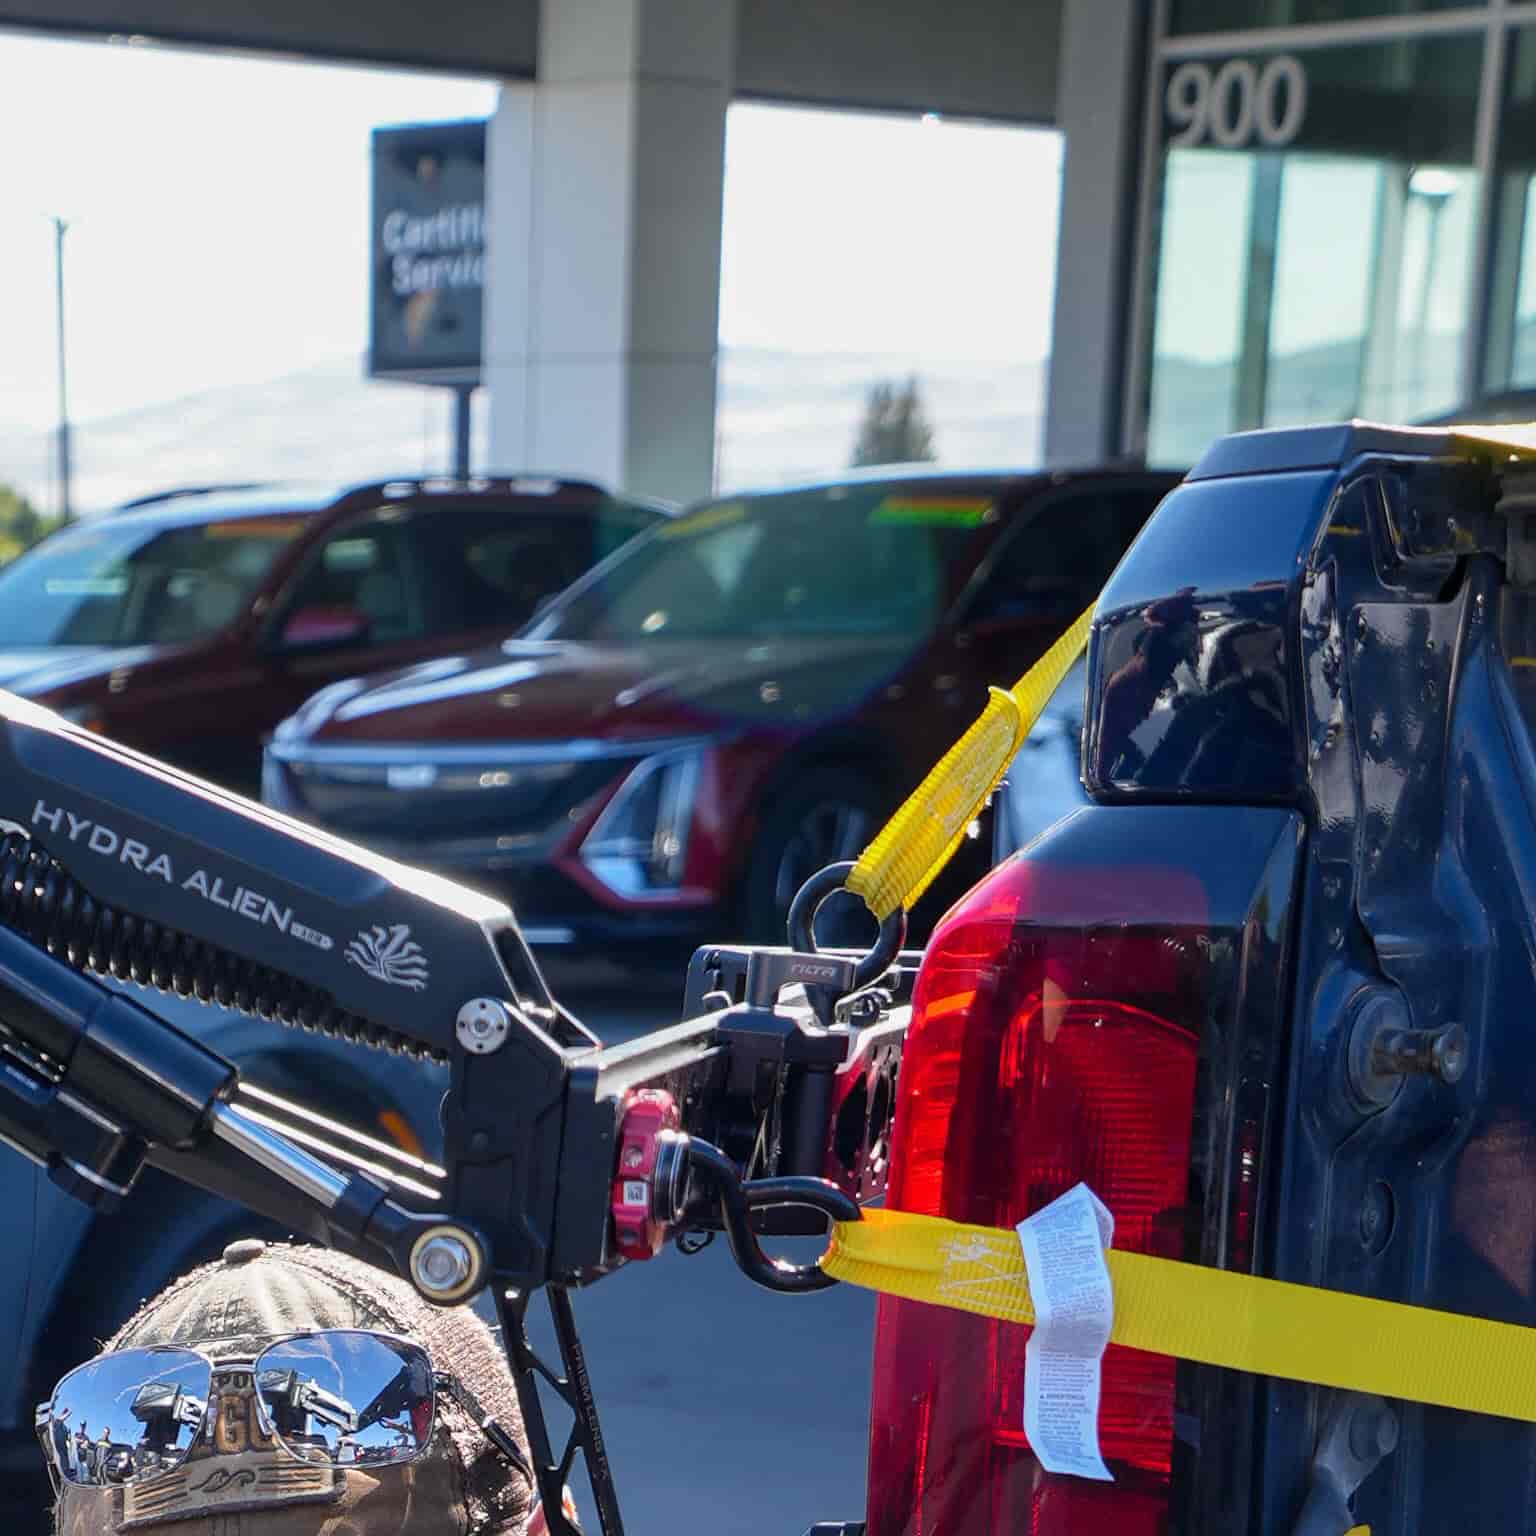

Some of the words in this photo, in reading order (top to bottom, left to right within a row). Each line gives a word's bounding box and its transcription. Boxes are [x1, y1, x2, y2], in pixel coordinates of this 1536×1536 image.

[1167, 57, 1306, 145] 900
[383, 206, 485, 254] Certifi
[392, 255, 484, 294] Servic
[31, 799, 174, 884] HYDRA
[180, 869, 294, 933] ALIEN
